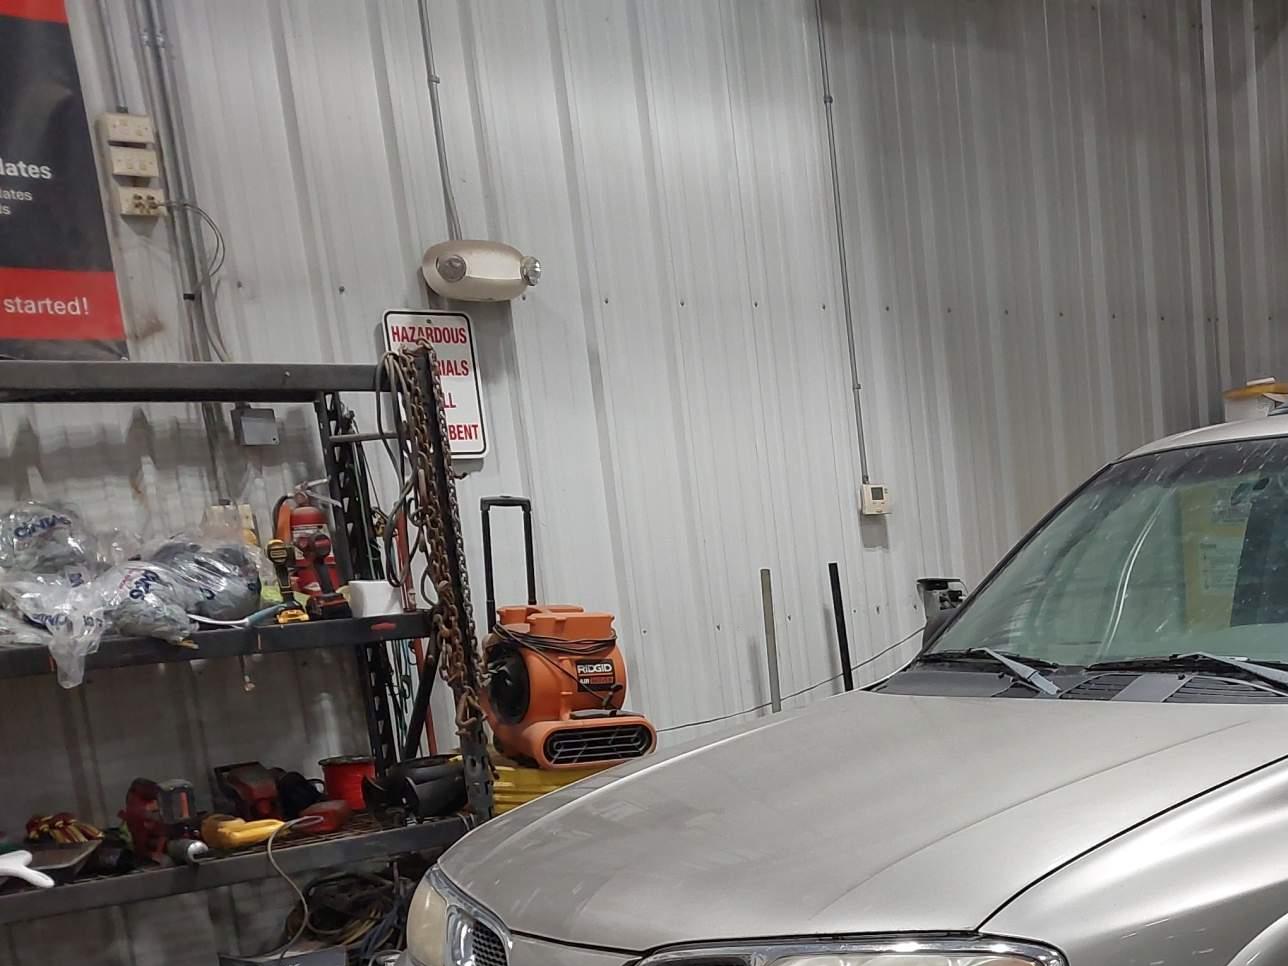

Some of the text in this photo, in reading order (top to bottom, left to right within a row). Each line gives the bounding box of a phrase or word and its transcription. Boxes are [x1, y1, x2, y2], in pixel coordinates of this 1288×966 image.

[0, 188, 33, 201] ates
[4, 297, 89, 315] started!
[391, 326, 467, 344] HAZARDOUS
[577, 663, 612, 673] RIDGID
